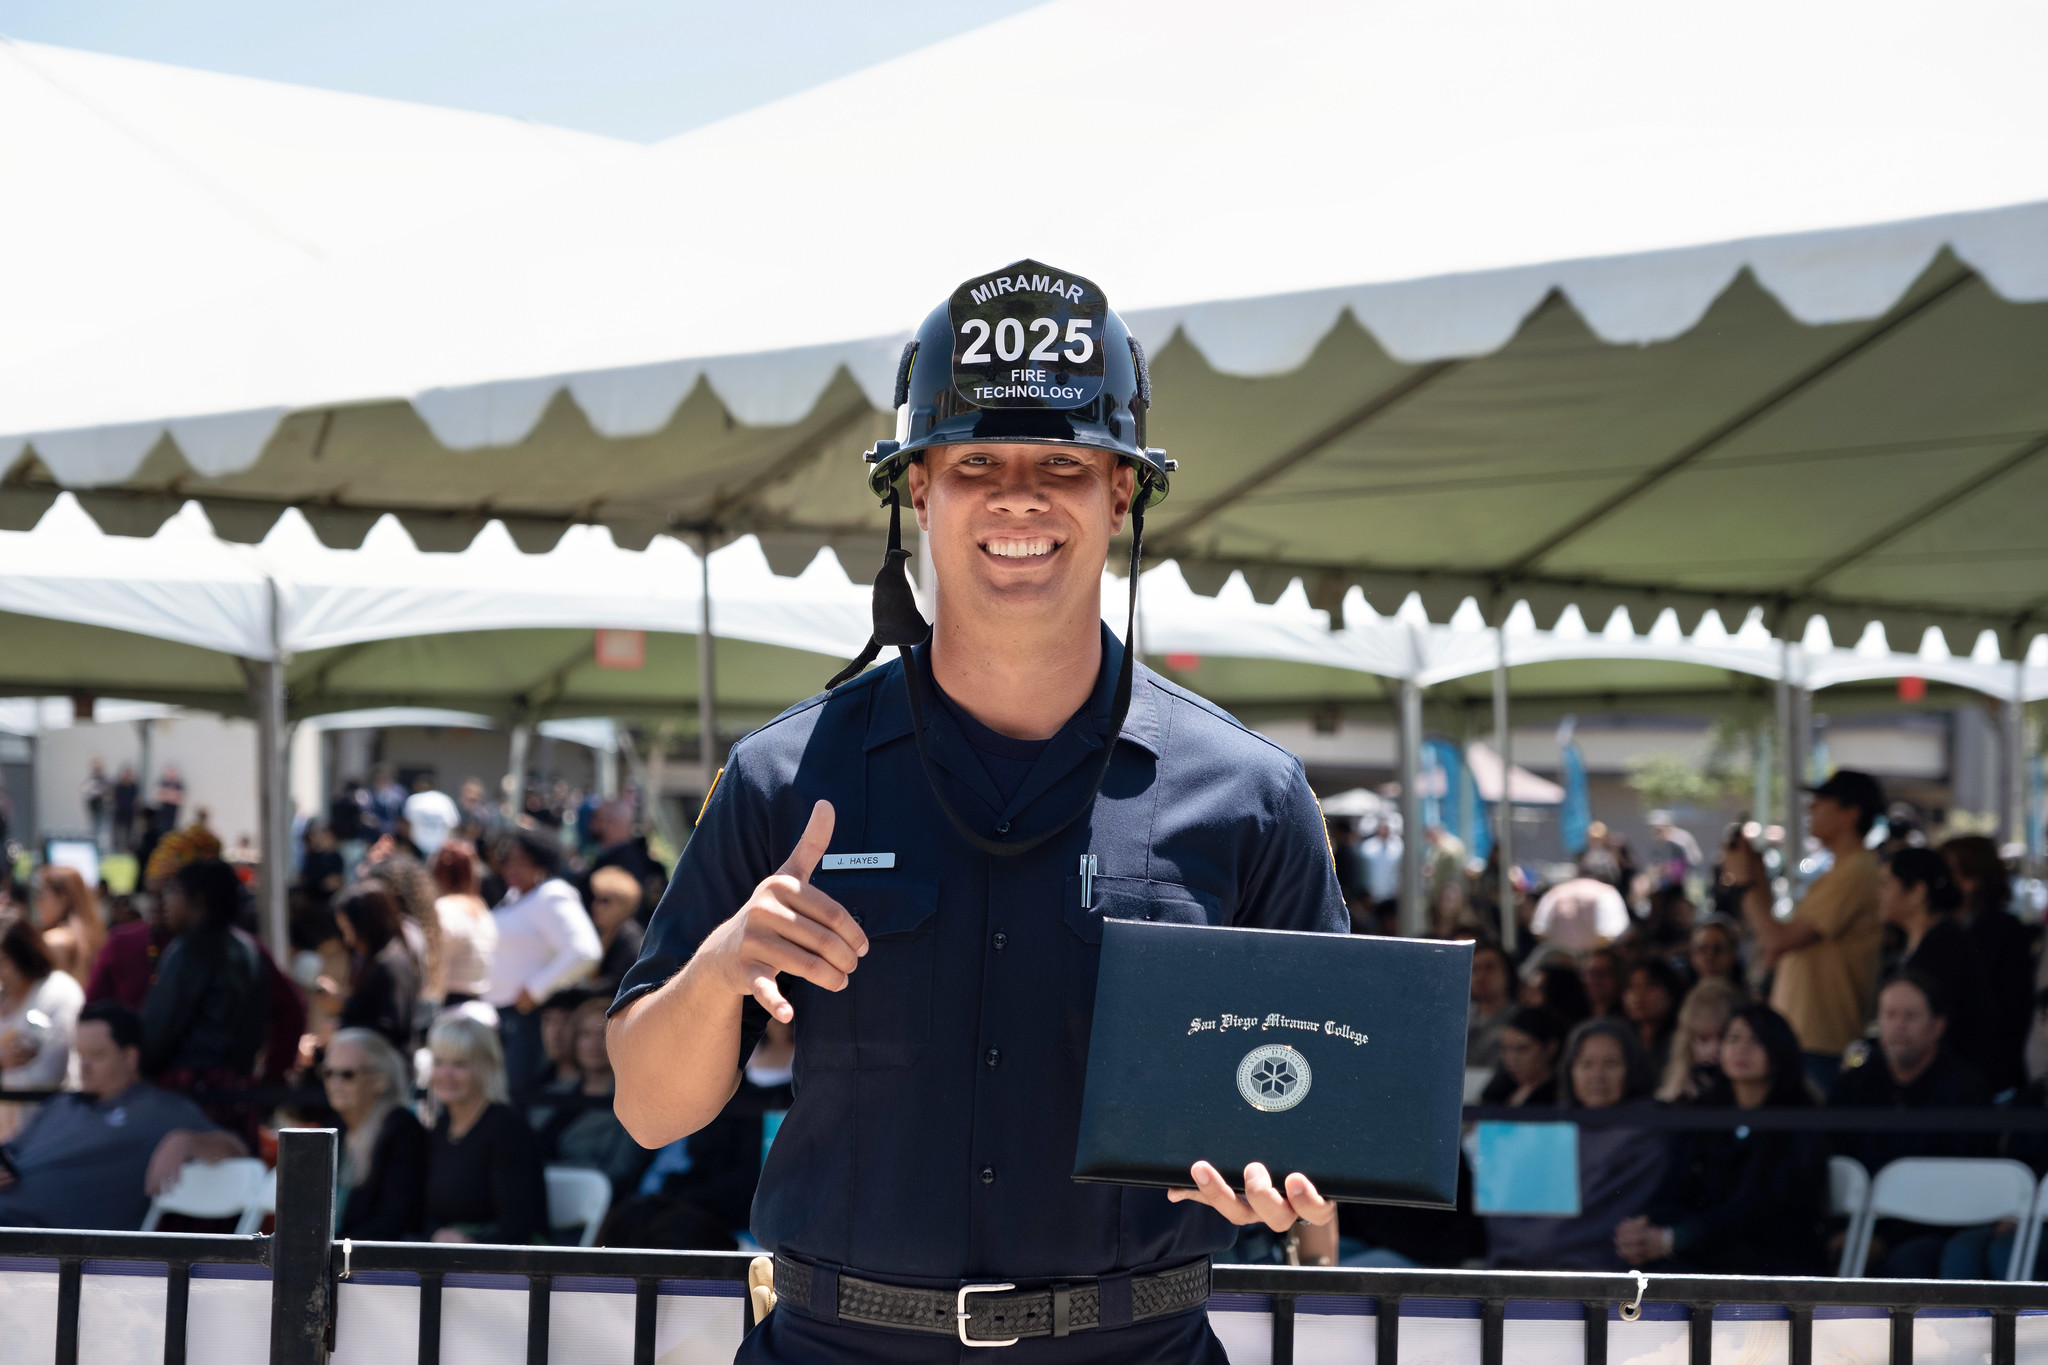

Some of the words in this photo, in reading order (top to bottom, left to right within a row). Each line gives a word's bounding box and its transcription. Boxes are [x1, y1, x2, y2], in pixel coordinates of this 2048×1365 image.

[970, 274, 1084, 305] MIRAMAR
[960, 317, 1094, 365] 2025
[1011, 369, 1046, 382] FIRE
[973, 385, 1084, 400] TECHNOLOGY
[837, 857, 844, 866] J.
[849, 856, 879, 865] HAYES
[1187, 1017, 1217, 1036] San
[1219, 1013, 1259, 1033] Diego
[1261, 1013, 1320, 1032] Miramar
[1324, 1020, 1369, 1046] College
